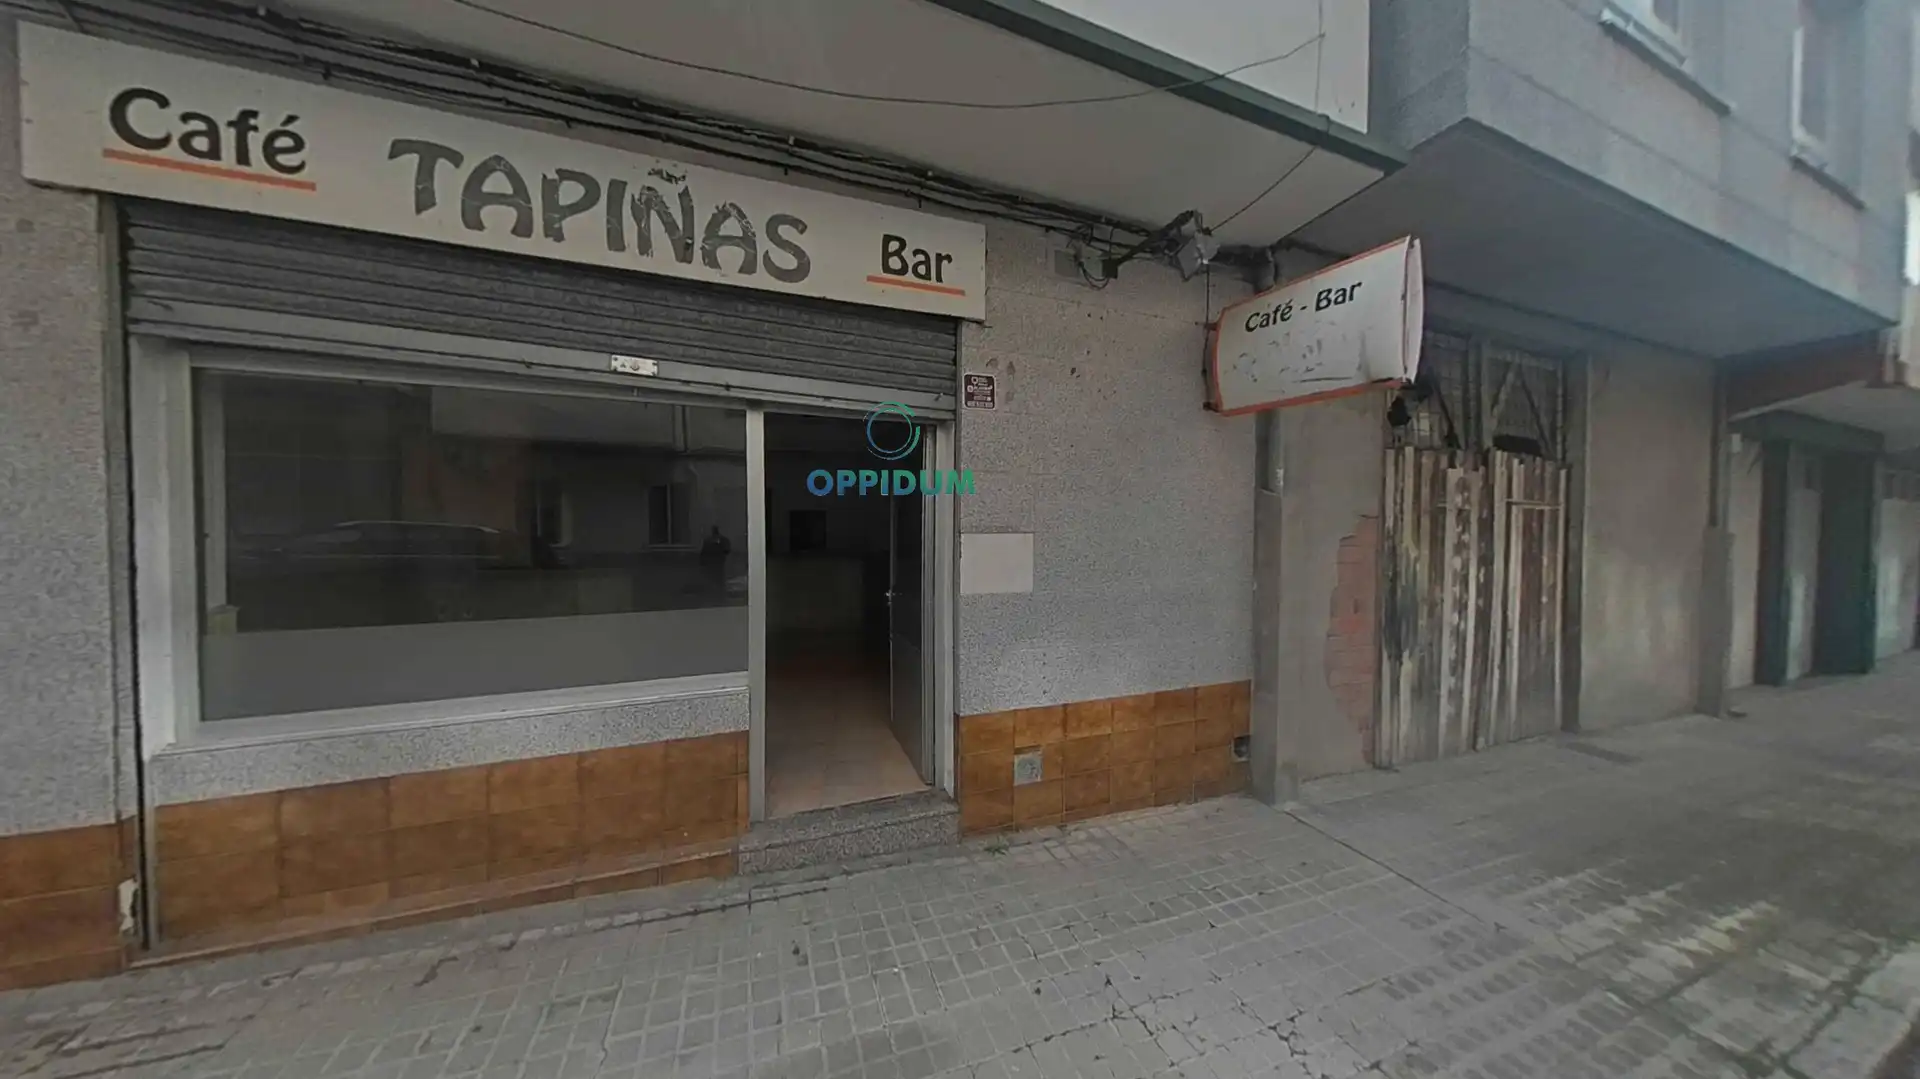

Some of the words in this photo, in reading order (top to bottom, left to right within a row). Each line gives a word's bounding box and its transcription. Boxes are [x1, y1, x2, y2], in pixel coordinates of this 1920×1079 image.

[109, 87, 306, 175] Café
[387, 138, 811, 284] TAPIÑAS
[880, 233, 953, 284] Bar
[1244, 299, 1293, 333] Café
[1315, 281, 1363, 312] Bar
